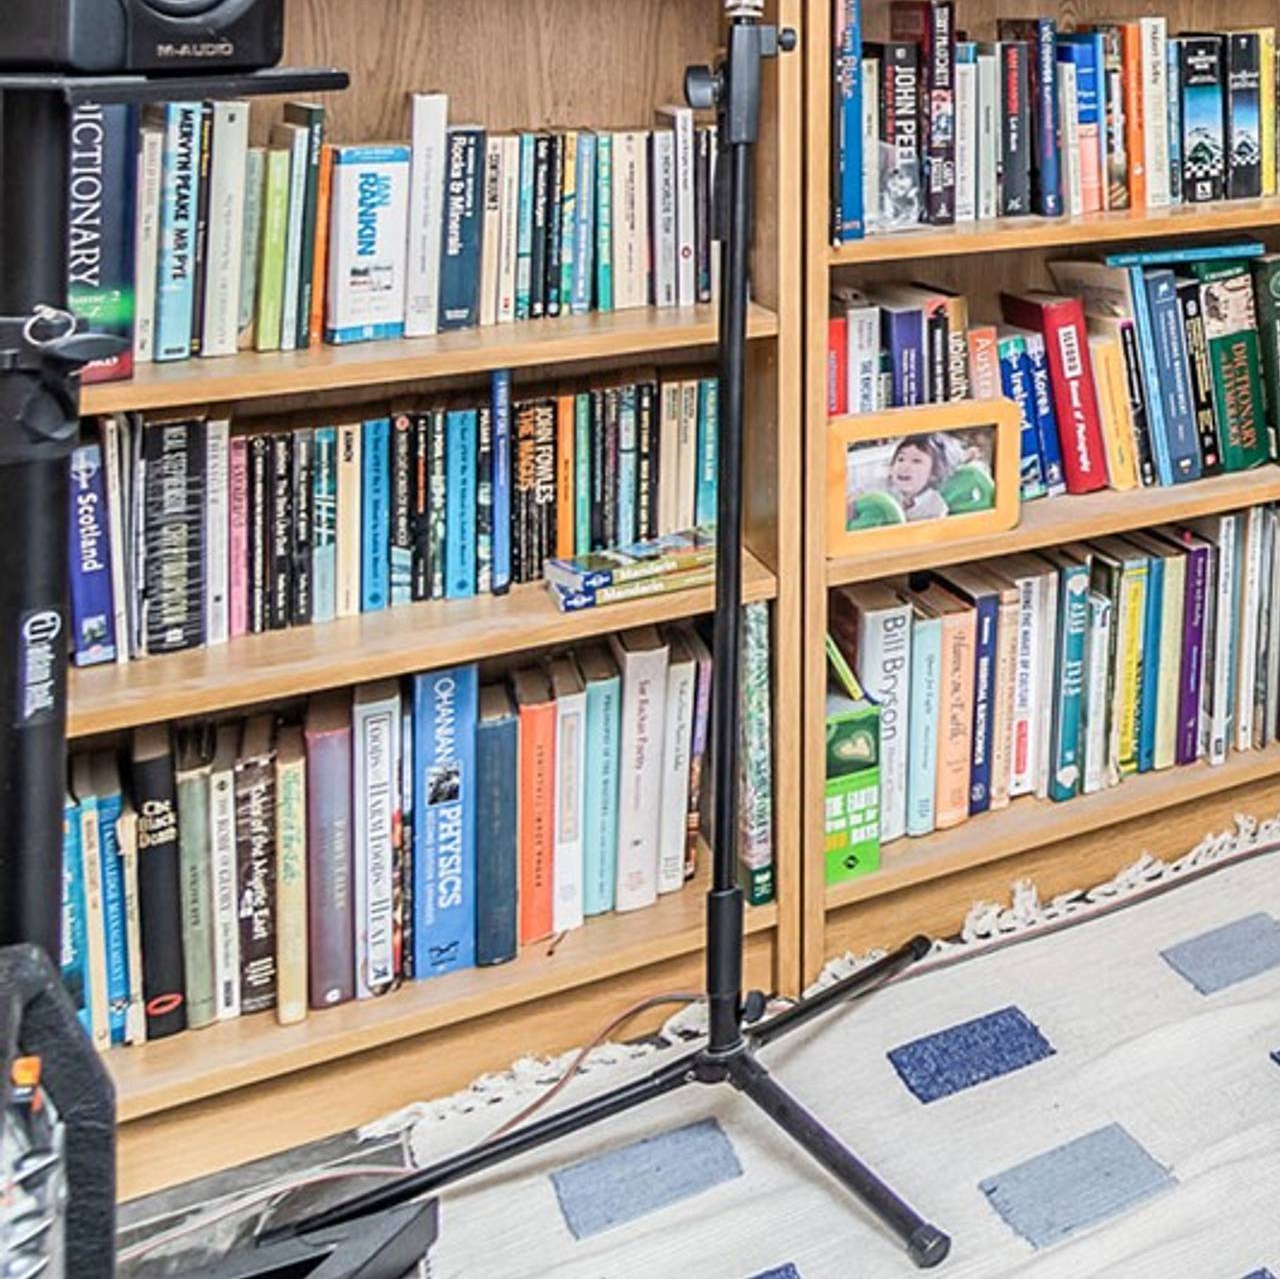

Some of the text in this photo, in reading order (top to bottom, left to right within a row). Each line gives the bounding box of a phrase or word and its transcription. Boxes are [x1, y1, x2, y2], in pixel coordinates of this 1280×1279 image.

[156, 42, 234, 58] M-AUDIO
[842, 56, 861, 99] Blake
[894, 65, 916, 167] JOHN PEEL
[172, 108, 194, 280] MERVYN PEAKE MR PYE
[377, 174, 393, 207] IAN
[451, 136, 467, 179] Rocks
[357, 172, 379, 256] RANKIN
[446, 196, 463, 256] Minerals
[947, 330, 969, 403] ubiquity
[1009, 371, 1032, 431] Ireland
[1032, 368, 1050, 416] Korea
[1233, 342, 1257, 449] DICTIONARY
[163, 426, 187, 449] NEAL
[343, 430, 353, 463] ASIMOV
[517, 409, 534, 491] THE MAGUS
[534, 406, 554, 504] JOHN FOWLES
[76, 493, 105, 573] Scotland
[882, 615, 906, 653] Bill
[1018, 581, 1033, 709] RIDING THE WAVES OF CULTURE
[880, 657, 906, 742] Bryson
[432, 676, 464, 909] OHANIAN PHYSICS
